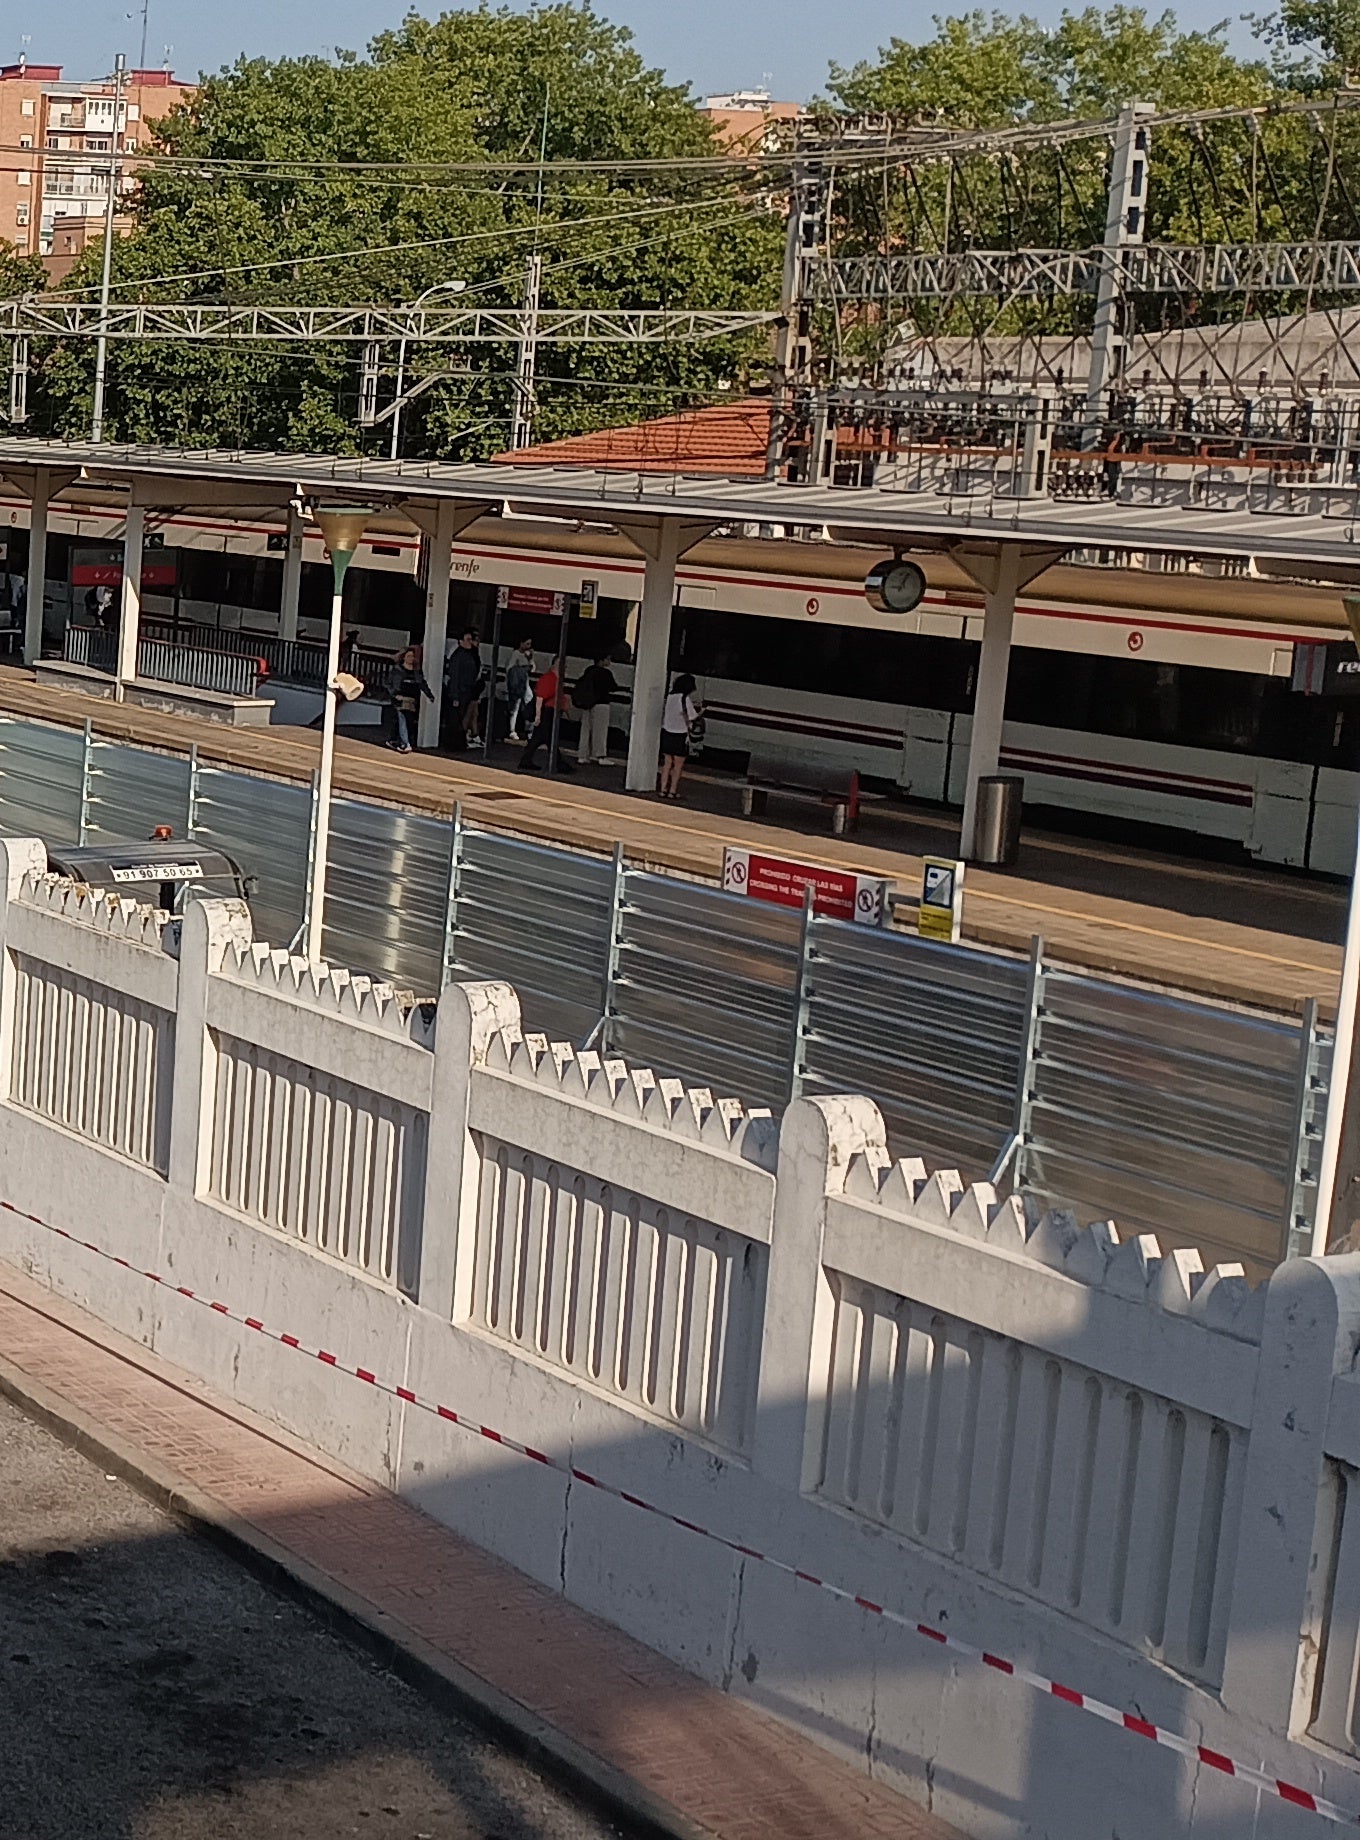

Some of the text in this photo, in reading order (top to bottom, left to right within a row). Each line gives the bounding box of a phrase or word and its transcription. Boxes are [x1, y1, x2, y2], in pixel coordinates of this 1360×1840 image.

[450, 558, 480, 578] renfe
[1337, 661, 1360, 673] re
[139, 869, 158, 878] 907
[163, 868, 176, 877] 50
